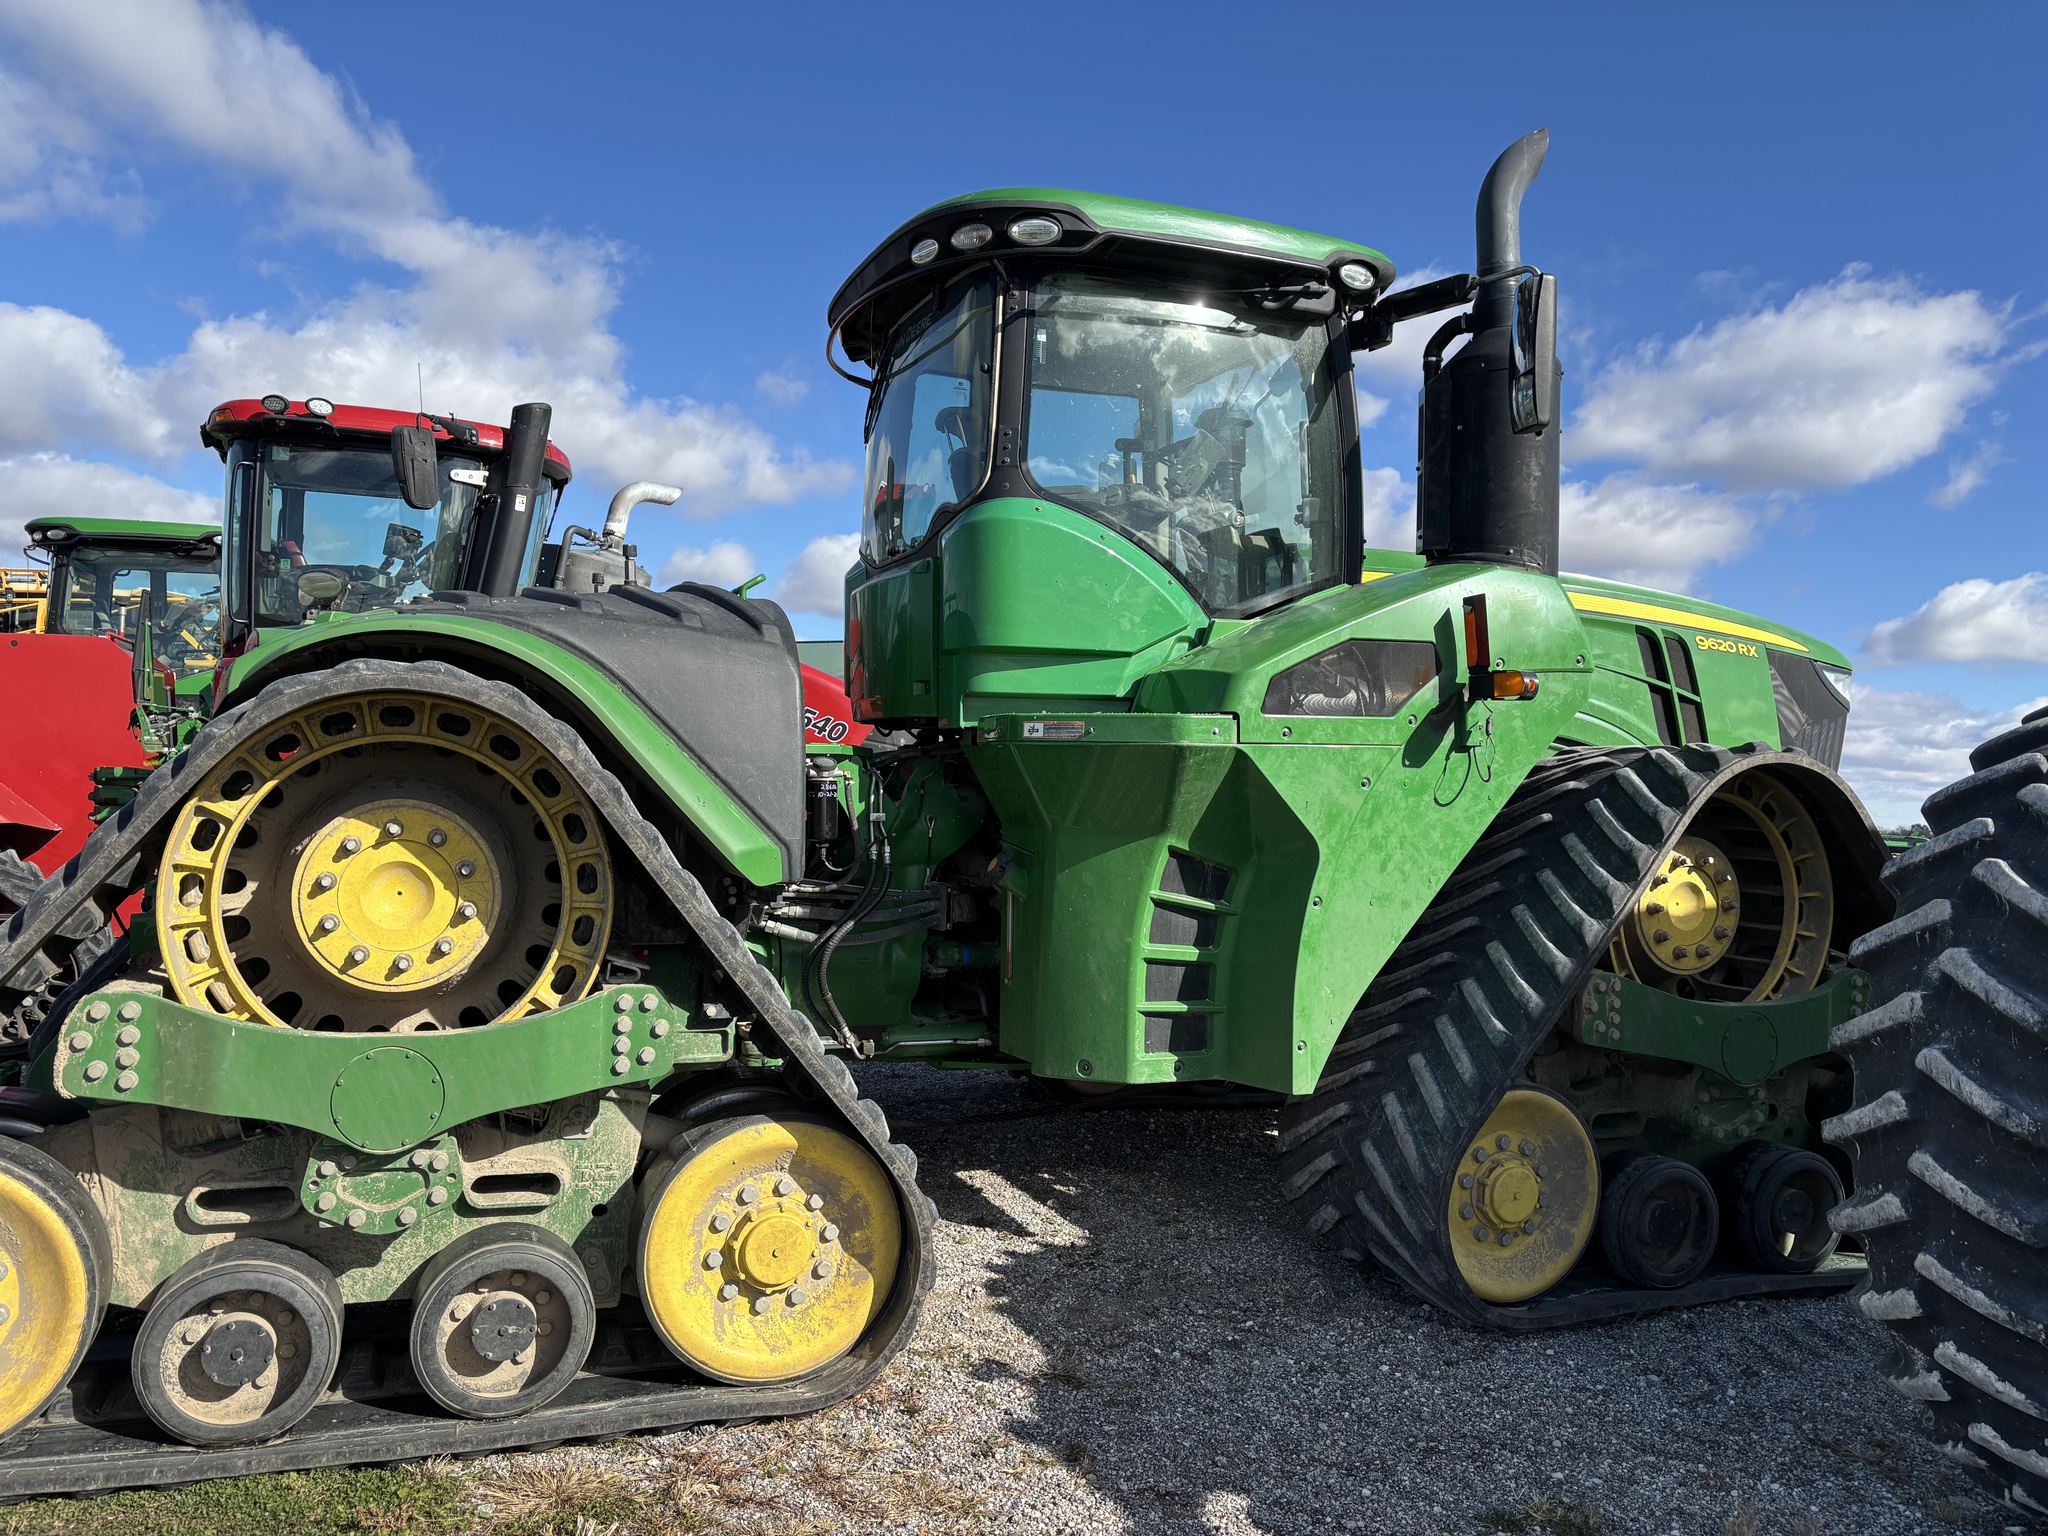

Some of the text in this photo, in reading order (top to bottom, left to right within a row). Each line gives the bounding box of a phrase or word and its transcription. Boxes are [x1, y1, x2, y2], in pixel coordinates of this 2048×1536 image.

[906, 312, 933, 343] DEERE
[1695, 635, 1759, 658] 9620 RX
[804, 706, 849, 743] 540
